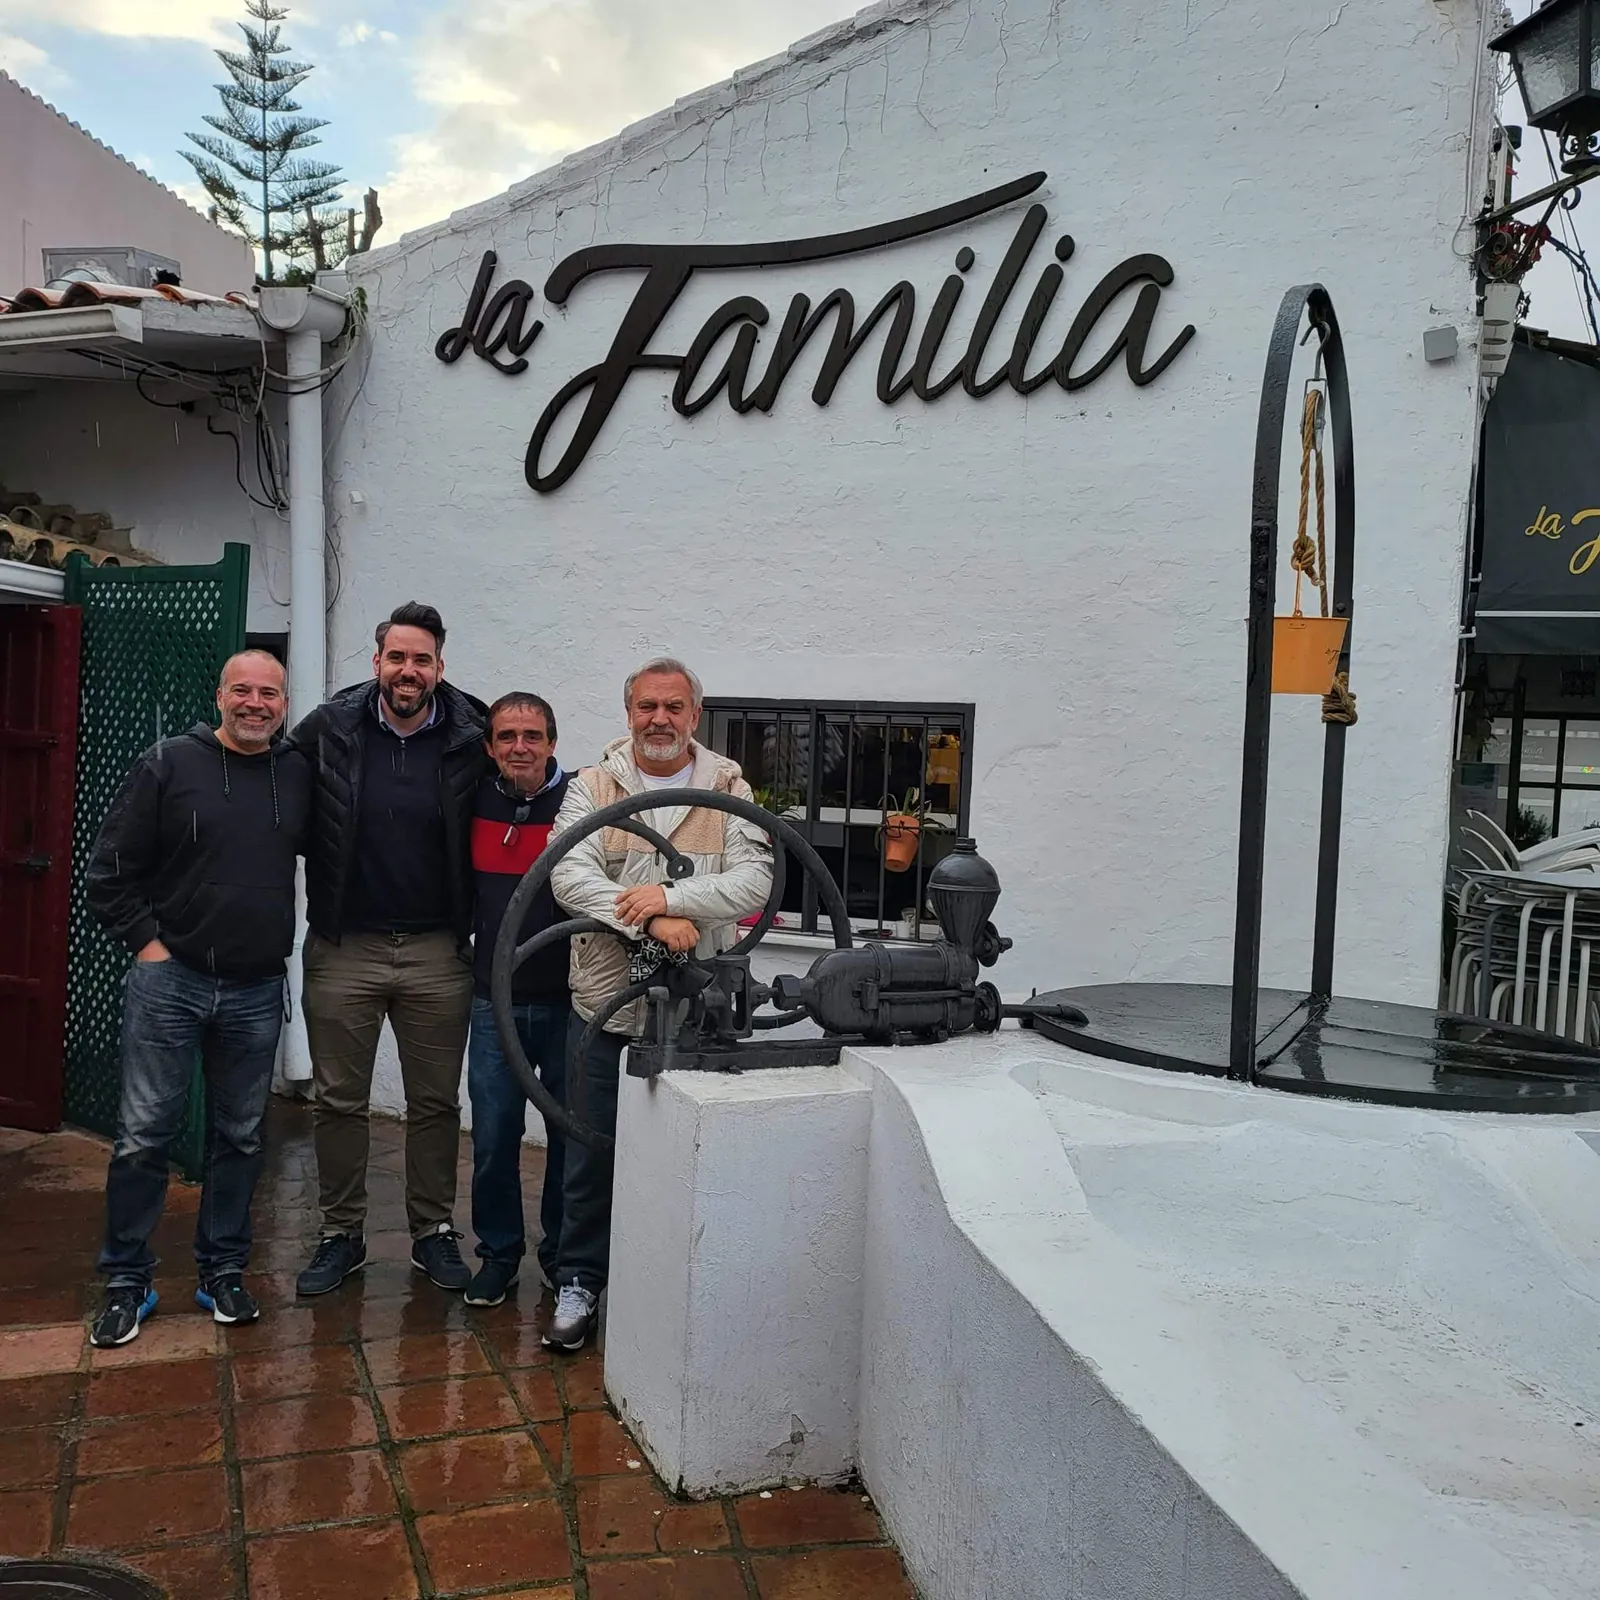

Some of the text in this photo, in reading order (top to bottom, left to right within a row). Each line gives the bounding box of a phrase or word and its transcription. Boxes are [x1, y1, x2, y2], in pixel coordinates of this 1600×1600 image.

[435, 171, 1196, 493] La Familia
[1524, 504, 1566, 540] La
